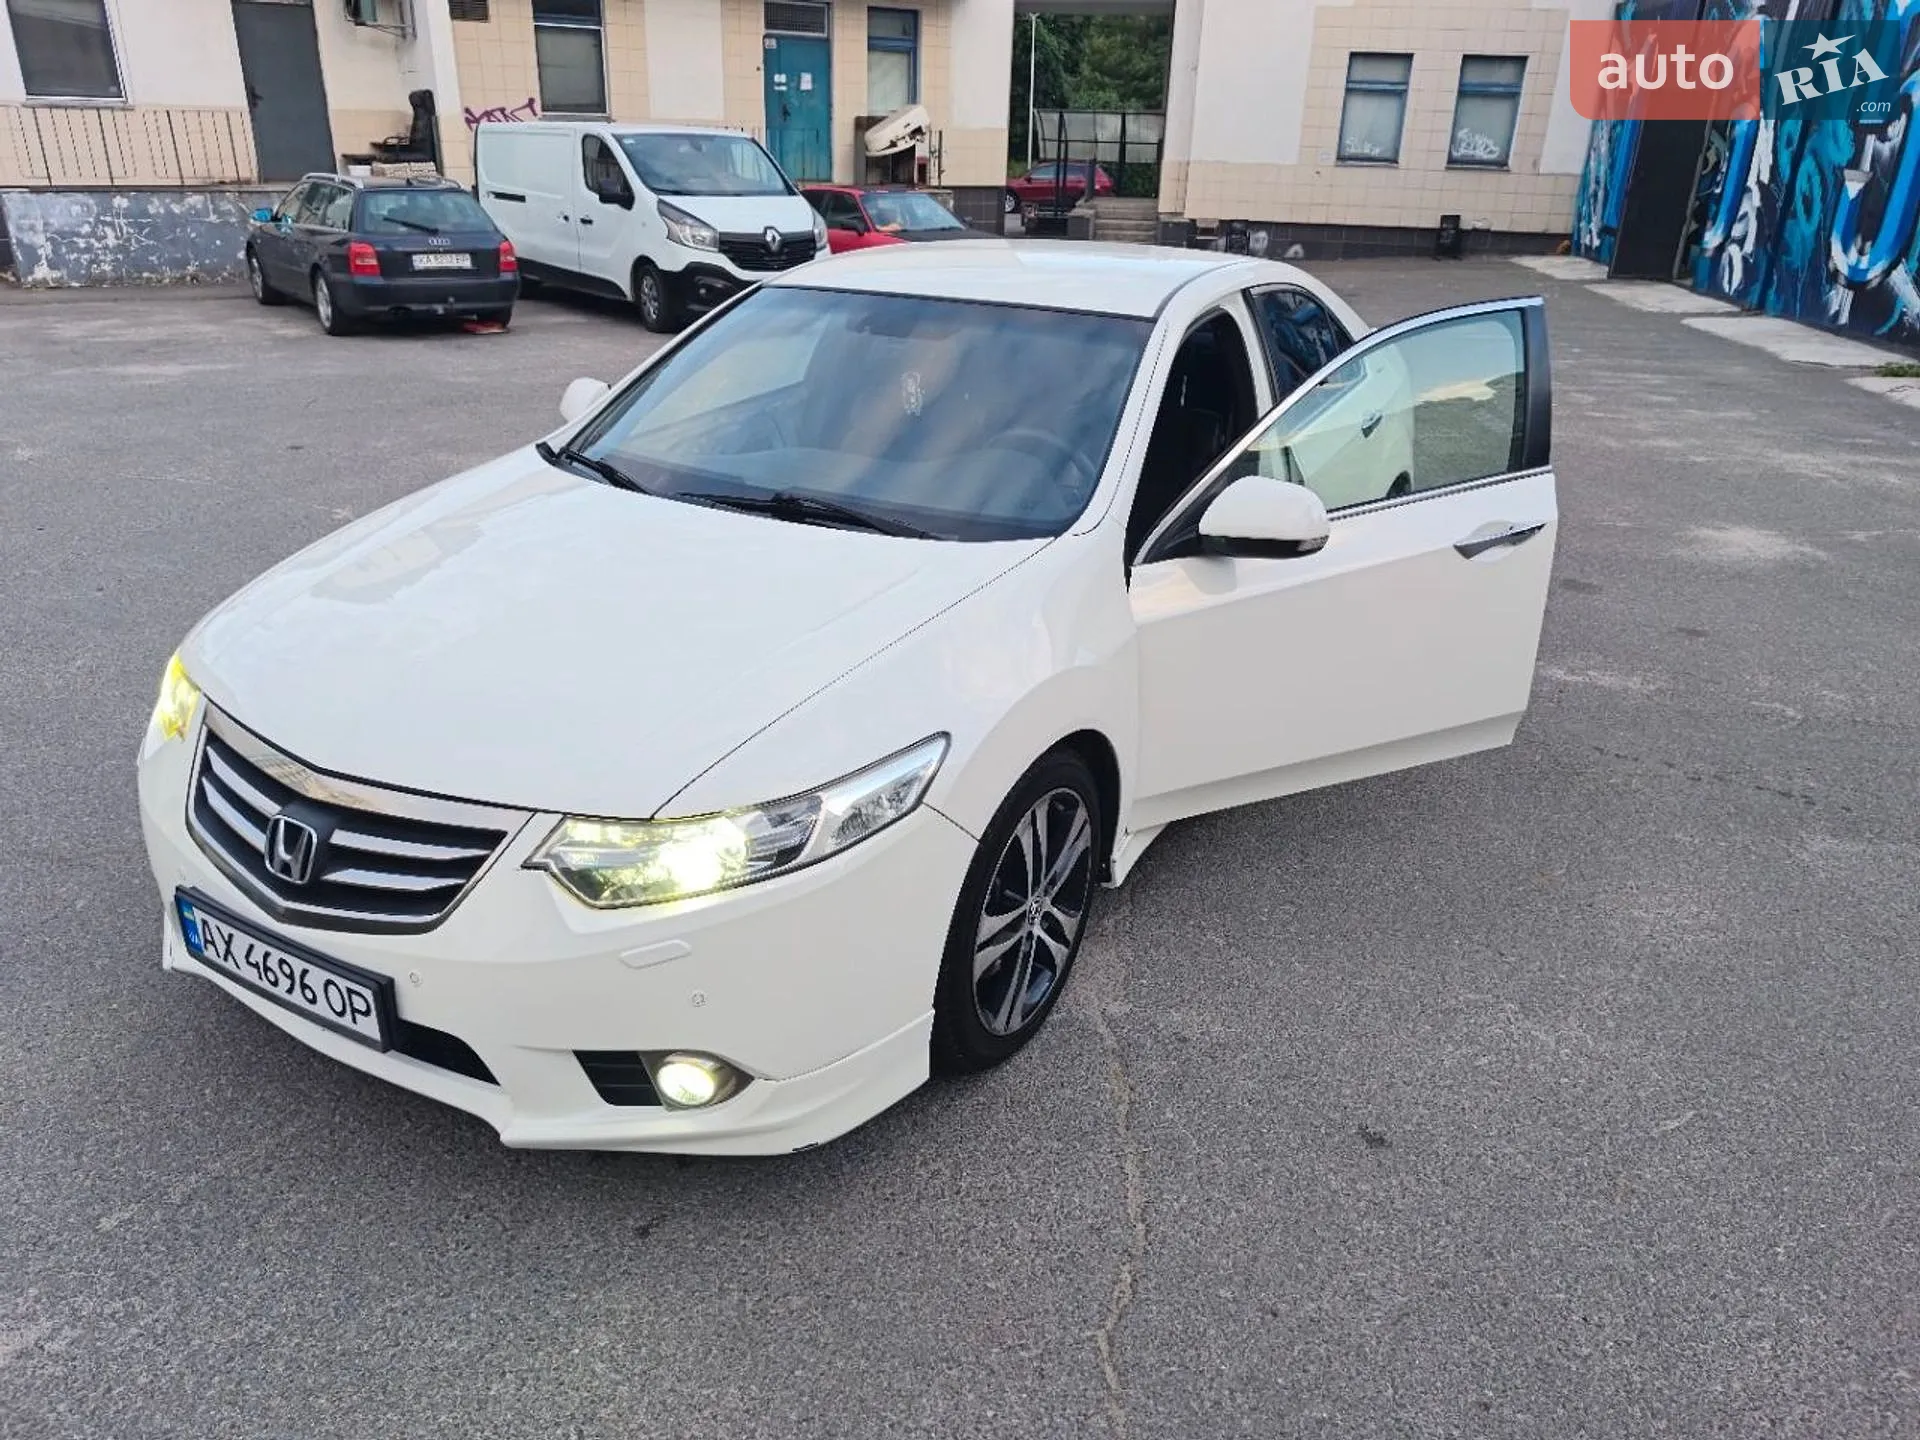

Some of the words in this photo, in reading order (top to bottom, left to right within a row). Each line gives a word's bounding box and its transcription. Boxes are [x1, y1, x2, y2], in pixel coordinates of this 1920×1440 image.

[201, 918, 241, 970] AX
[245, 943, 318, 1005] 4696
[323, 978, 372, 1025] OP
